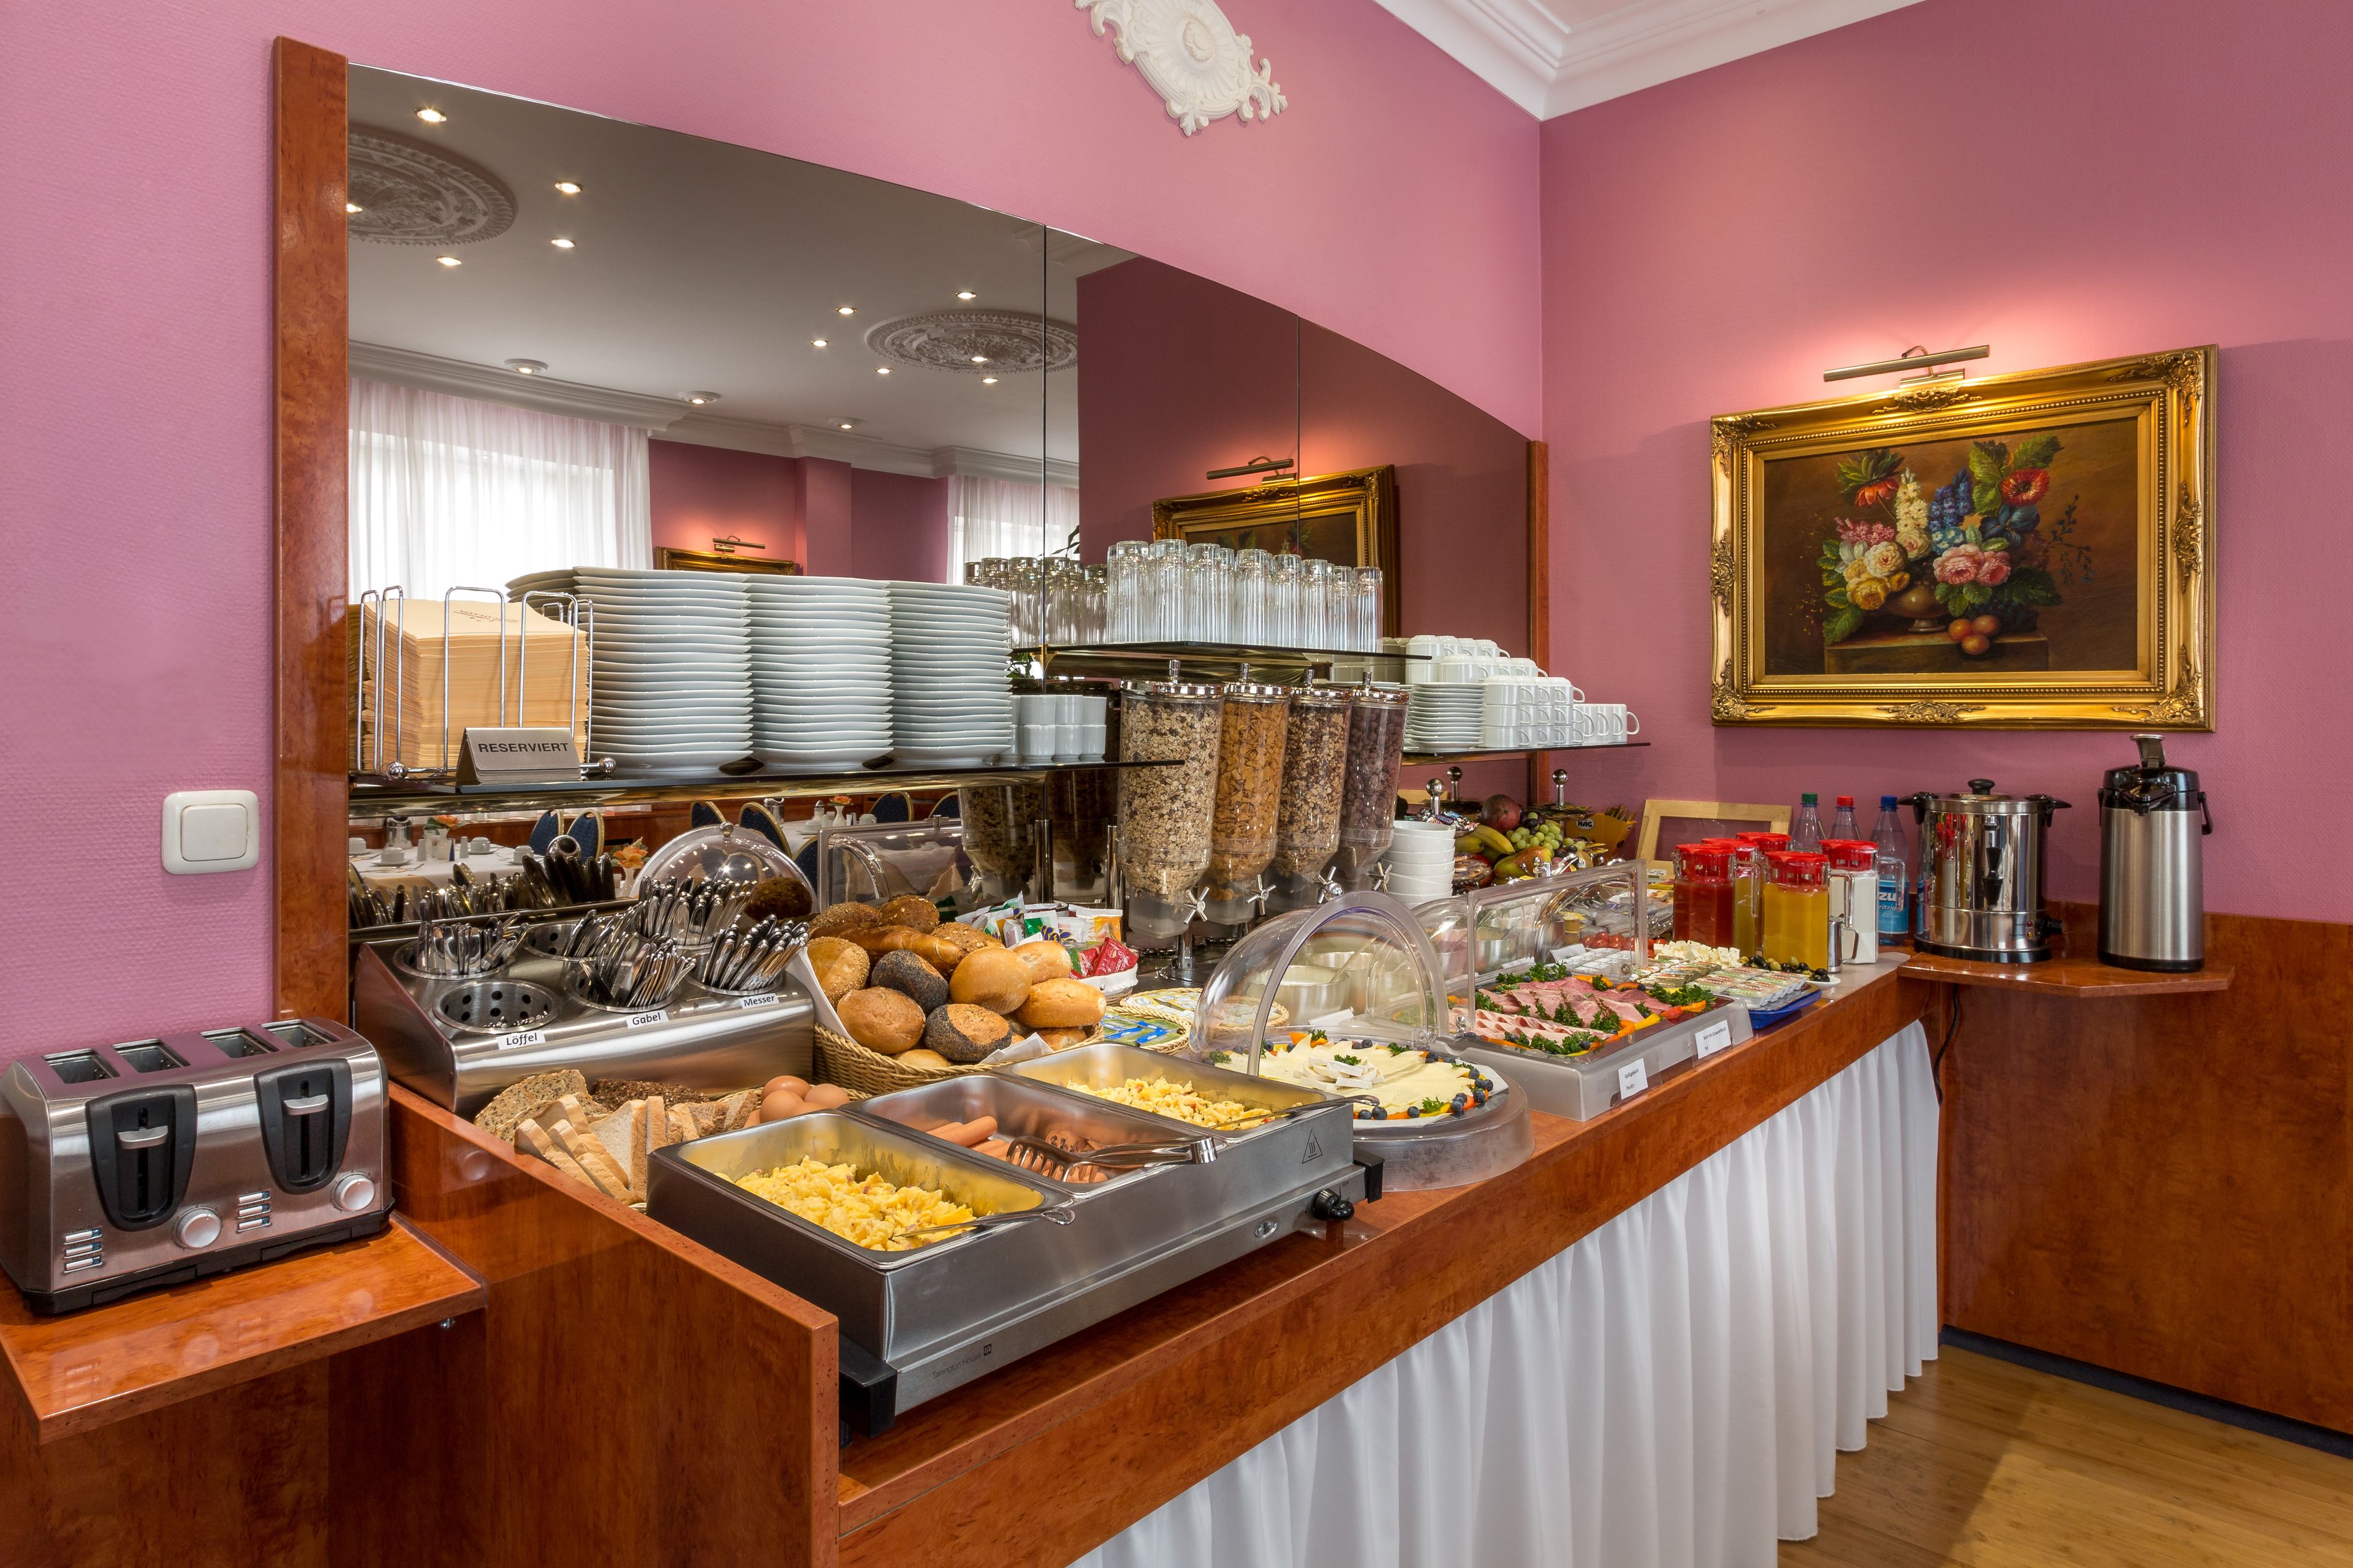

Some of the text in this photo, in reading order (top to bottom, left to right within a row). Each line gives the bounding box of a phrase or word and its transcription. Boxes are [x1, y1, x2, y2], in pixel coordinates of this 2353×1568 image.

[478, 743, 569, 752] RESERVIERT
[1879, 892, 1896, 901] zu
[743, 996, 775, 1007] Messer
[632, 1012, 661, 1026] Gabel
[506, 1032, 537, 1047] Löffel
[962, 1352, 982, 1366] House
